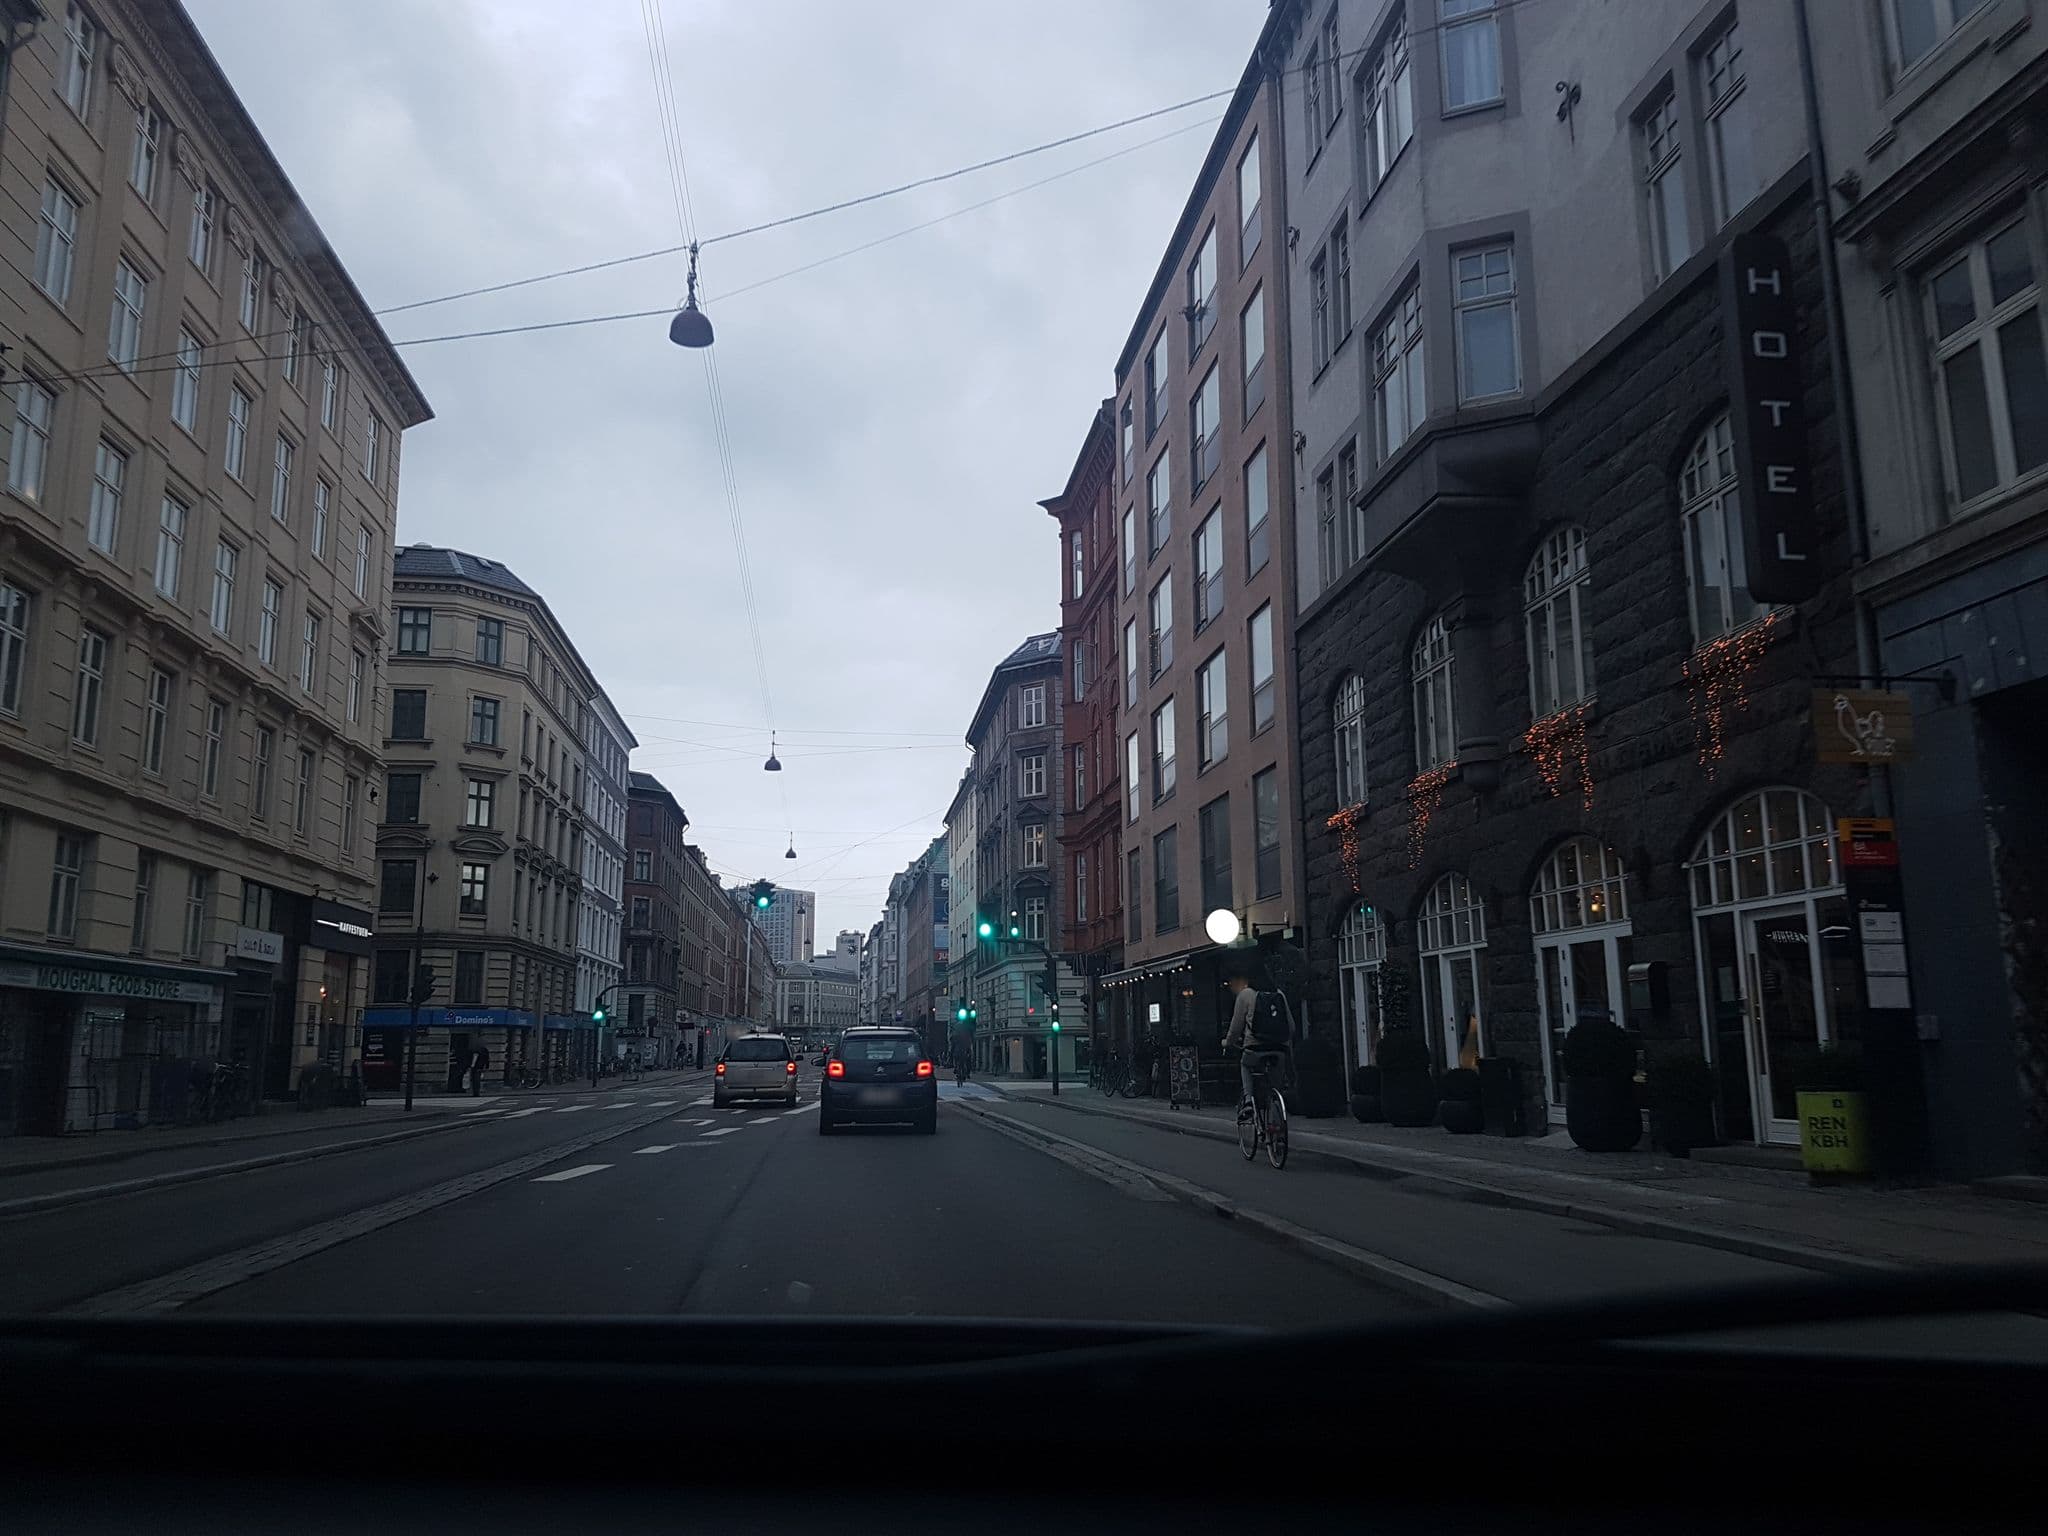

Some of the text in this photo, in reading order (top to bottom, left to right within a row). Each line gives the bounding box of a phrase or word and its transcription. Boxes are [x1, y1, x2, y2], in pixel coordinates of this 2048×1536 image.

[1747, 266, 1807, 561] HOTEL
[37, 966, 104, 992] MOUGHAL
[108, 975, 140, 994] FOOD
[144, 977, 181, 998] STORE
[455, 1015, 495, 1025] Domino's
[1807, 1116, 1847, 1130] REN
[1810, 1135, 1848, 1148] KBH
